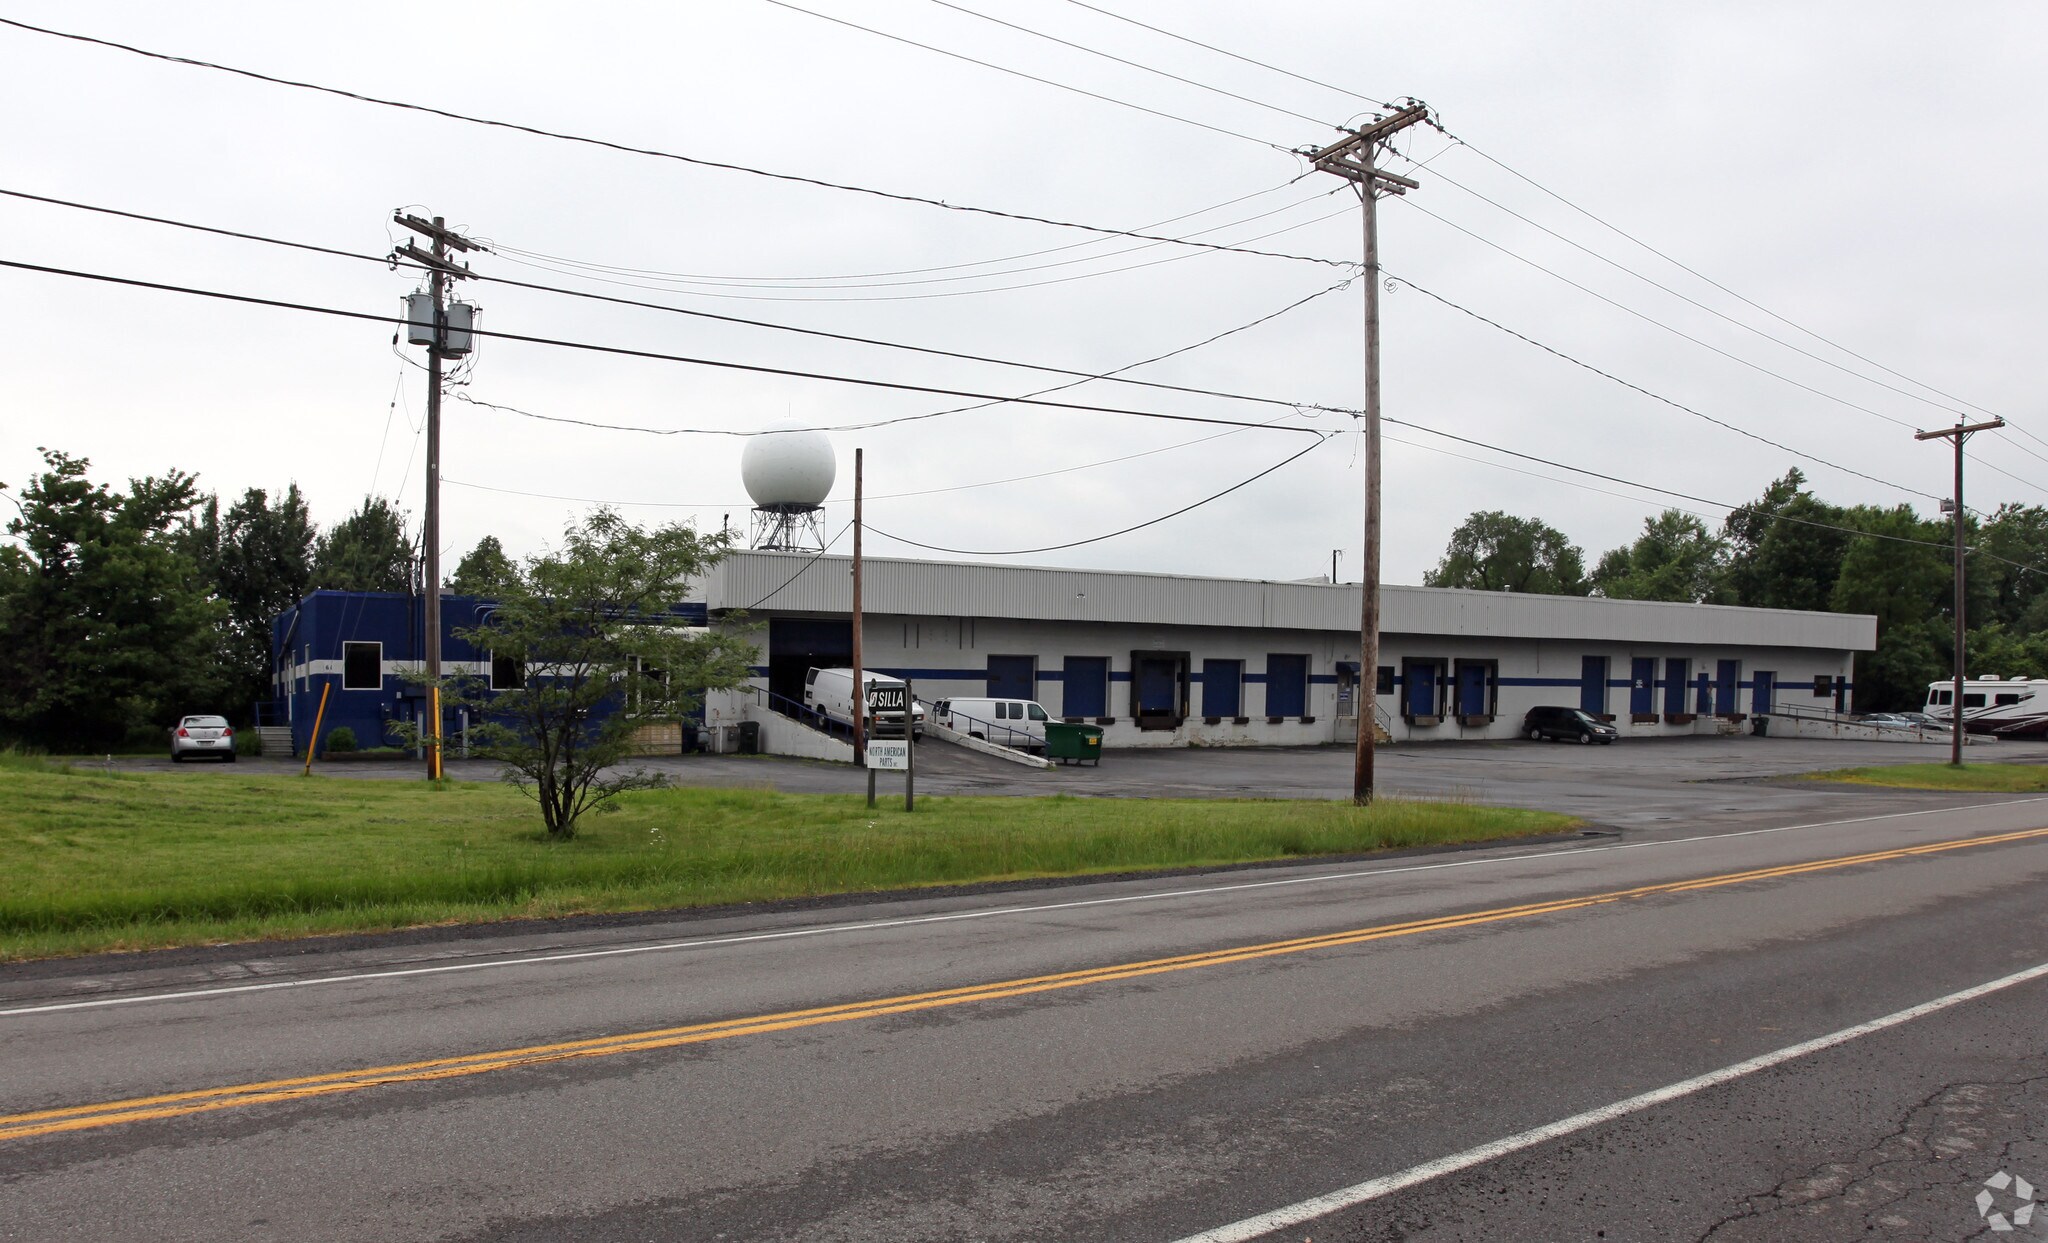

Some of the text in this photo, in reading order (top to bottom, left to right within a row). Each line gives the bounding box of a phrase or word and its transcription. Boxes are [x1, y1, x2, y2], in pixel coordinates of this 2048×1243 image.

[878, 691, 904, 707] SILLA
[869, 746, 906, 757] NORTH AMERICAN
[879, 757, 893, 767] PARTS
